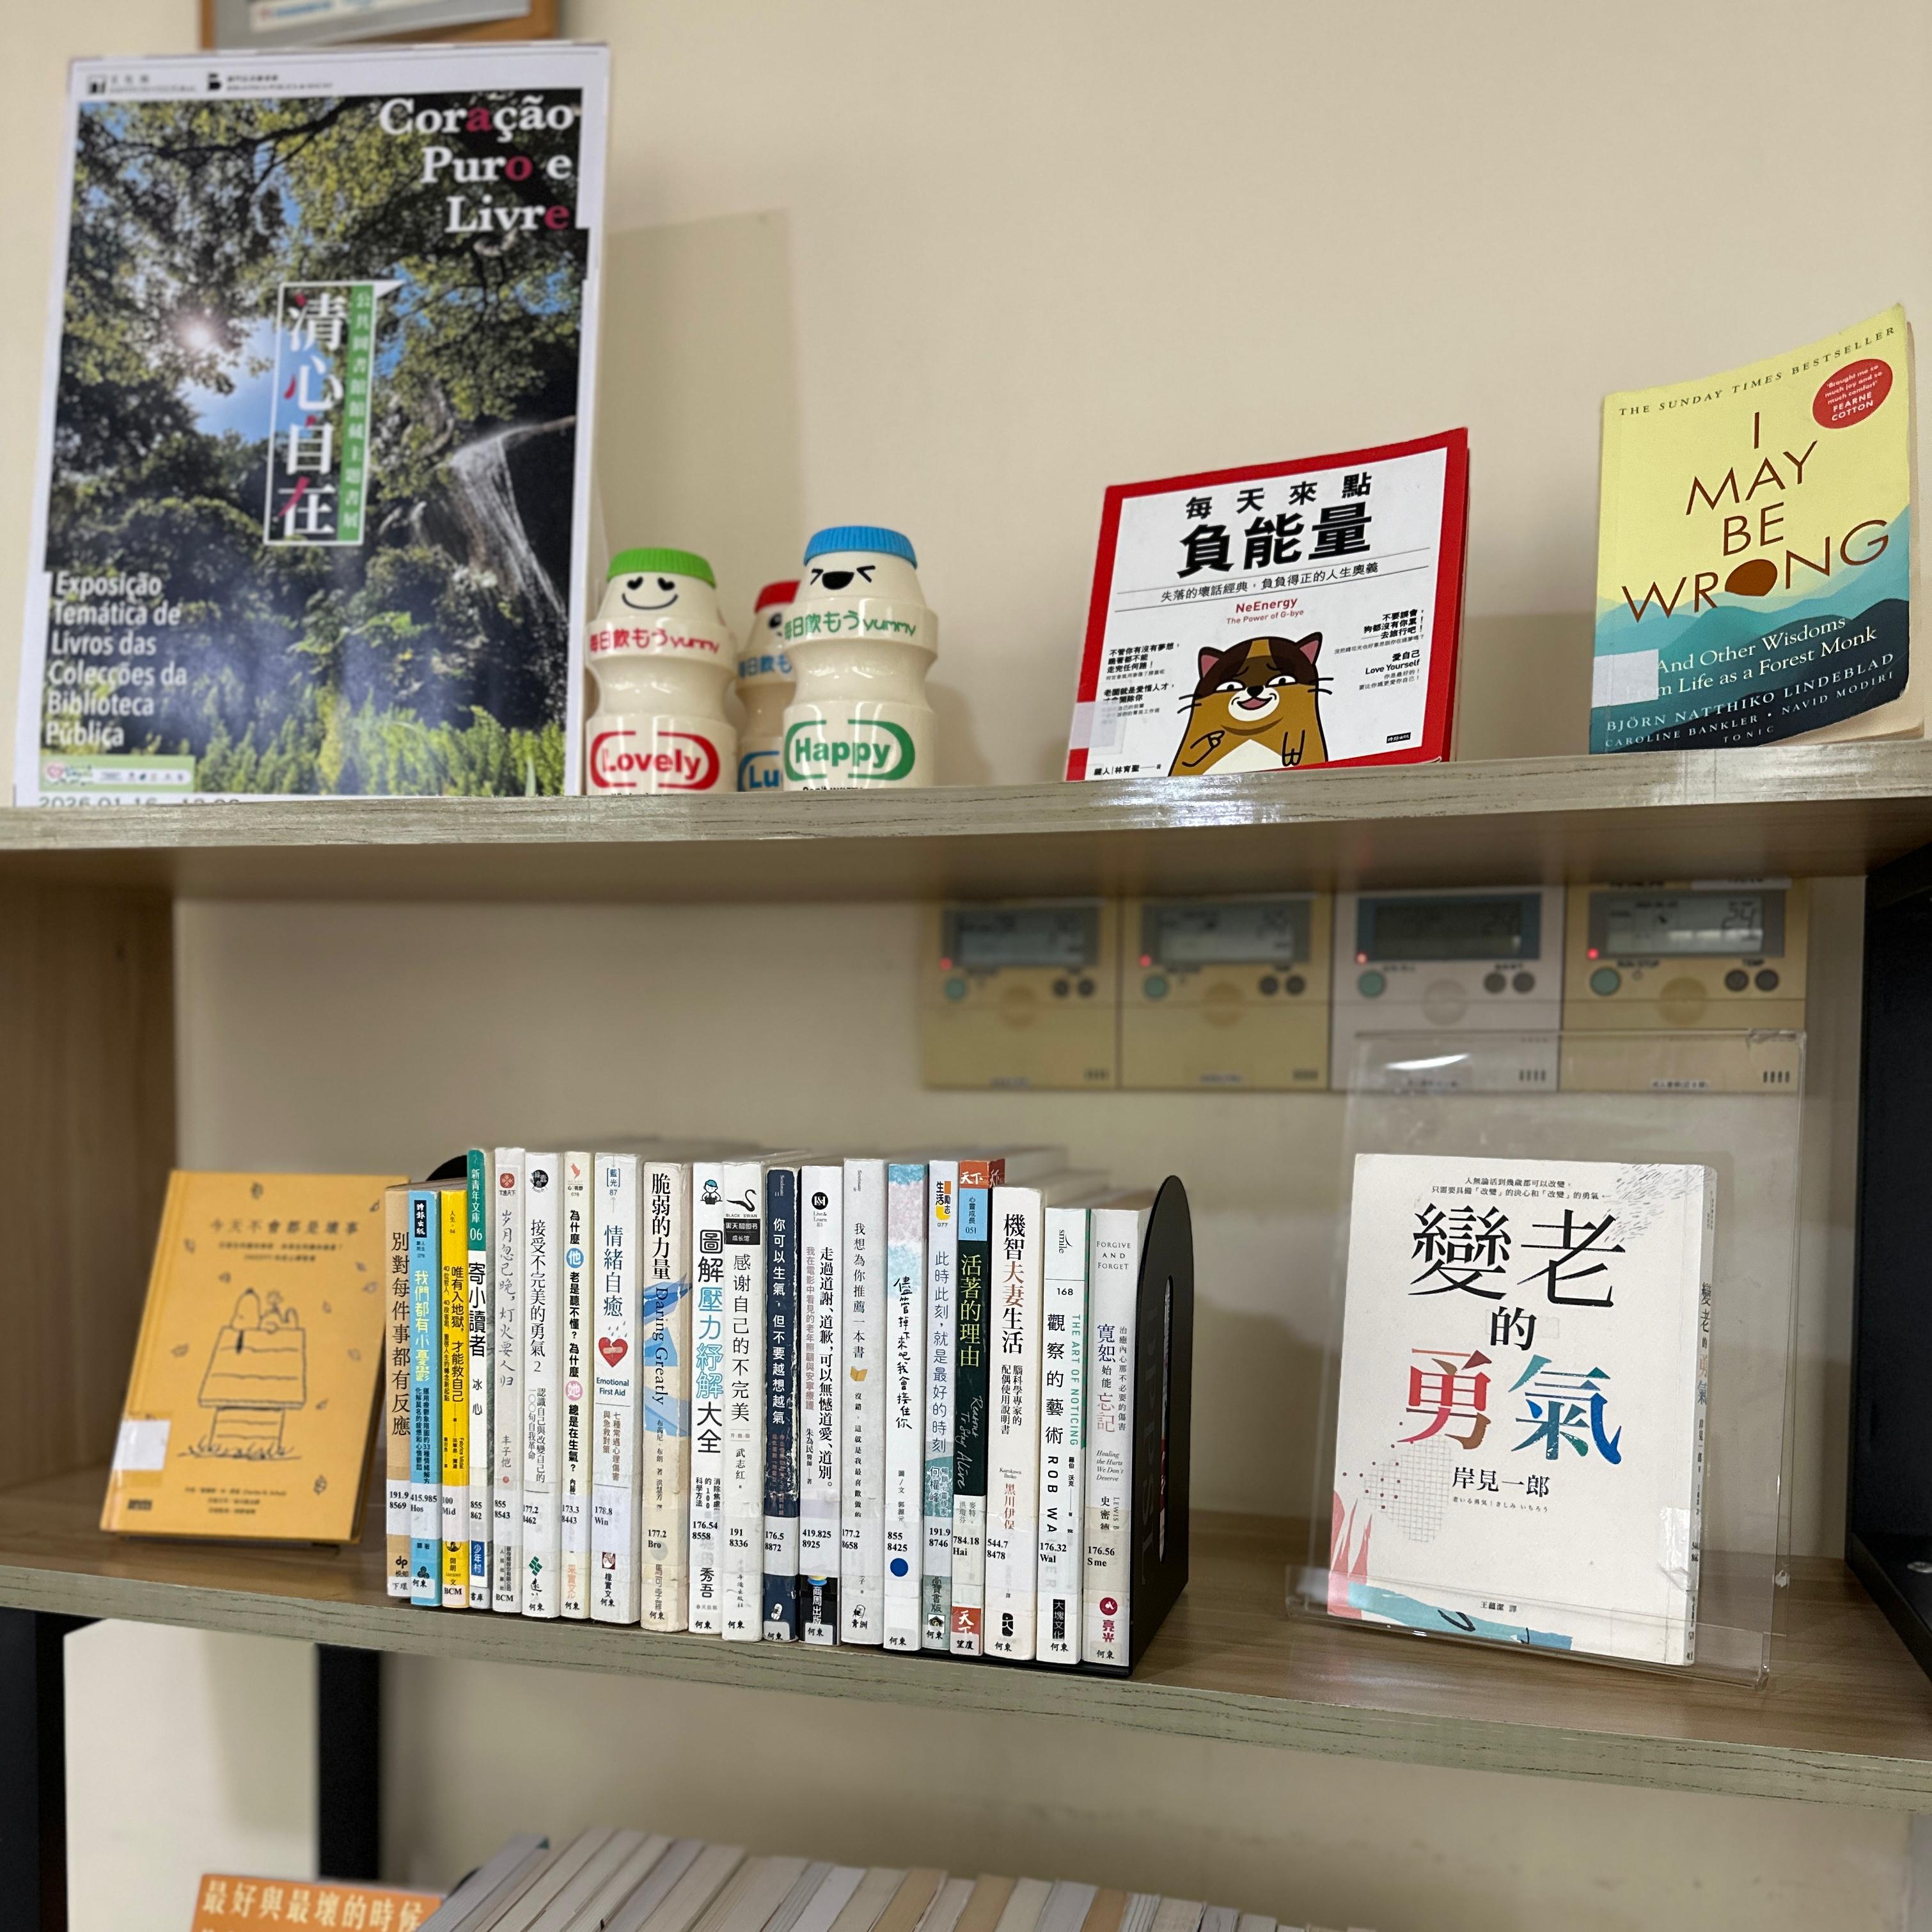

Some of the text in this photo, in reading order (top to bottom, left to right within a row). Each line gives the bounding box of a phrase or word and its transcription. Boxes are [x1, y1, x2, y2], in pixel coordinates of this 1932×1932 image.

[380, 97, 574, 143] Coração
[421, 146, 571, 183] Puro e
[444, 196, 570, 233] Livre
[1619, 326, 1896, 416] THE SUNDAY TIMES BESTSELLER
[1833, 391, 1873, 412] FEARNE
[277, 292, 349, 537] 清心自在
[1831, 400, 1874, 421] COTTON
[1753, 411, 1760, 450] I
[1685, 440, 1818, 516] MAY
[1185, 471, 1372, 520] 每天來點
[1723, 501, 1785, 556] BE
[1177, 501, 1373, 579] 負能量
[1622, 518, 1890, 624] WRONG
[56, 570, 162, 602] Exposição
[1236, 598, 1298, 613] NeEnergy
[52, 601, 182, 626] Temática de
[1227, 617, 1241, 625] The
[1243, 614, 1269, 624] Power
[51, 630, 157, 656] Livros das
[1699, 617, 1846, 667] Other Wisdoms
[1392, 649, 1420, 662] 愛自己
[1678, 673, 1714, 693] Life
[1720, 672, 1738, 685] as
[1743, 669, 1753, 679] a
[1759, 648, 1815, 677] Forest
[1820, 626, 1878, 658] Monk
[1365, 658, 1420, 675] Love Yourself
[48, 659, 188, 691] Colecções da
[1606, 713, 1667, 732] BJÖRN
[1675, 691, 1775, 723] NATTHIKO
[1784, 652, 1895, 698] LINDEBLAD
[47, 690, 155, 717] Biblioteca
[1605, 671, 1894, 748] CAROLINE BANKLER NAVID MODIRI
[45, 720, 125, 747] Pública
[1723, 725, 1775, 744] TONIC
[795, 737, 891, 770] Happy
[602, 748, 702, 781] Lovely
[651, 1172, 671, 1280] 脆弱的力量
[469, 1227, 483, 1241] 06
[1096, 1241, 1131, 1249] FORGIVE
[1408, 1202, 1626, 1308] 變老
[603, 1225, 624, 1317] 情緒自癒
[1097, 1262, 1129, 1270] FORGET
[530, 1219, 546, 1357] 接受不完美的勇氣
[1001, 1213, 1026, 1355] 機智夫妻生活
[853, 1222, 866, 1359] 我想為你推薦一本書
[1056, 1287, 1074, 1296] 168
[468, 1262, 487, 1358] 寄小讀者
[959, 1253, 982, 1368] 活著的理由
[391, 1231, 411, 1436] 別對每件事都有反應
[1489, 1305, 1537, 1351] 的
[696, 1229, 725, 1454] 圖解壓力紓解大全
[731, 1253, 751, 1422] 感谢自己的不完美
[652, 1287, 669, 1406] Daring Greatly
[931, 1251, 950, 1454] 此時此刻，就是最好的時刻
[596, 1377, 630, 1387] Emotional
[1045, 1313, 1066, 1445] 觀察的藝術
[1069, 1314, 1081, 1445] THE ART OF NOTICING
[471, 1378, 483, 1415] 冰心
[599, 1386, 626, 1397] First Aid
[1396, 1347, 1623, 1465] 勇氣
[501, 1434, 512, 1468] 丰子恺
[1096, 1450, 1120, 1459] Healing
[735, 1448, 746, 1480] 武志红
[1047, 1456, 1059, 1493] ROB
[1452, 1466, 1551, 1498] 岸見一郎
[389, 1491, 409, 1500] 191.9
[410, 1493, 437, 1502] 415.985
[389, 1501, 407, 1509] 8569
[410, 1504, 424, 1512] Hos
[470, 1501, 483, 1509] 855
[494, 1500, 507, 1508] 855
[562, 1505, 579, 1514] 173.3
[470, 1512, 483, 1520] 862
[494, 1511, 511, 1520] 8543
[594, 1505, 613, 1516] 178.8
[594, 1516, 609, 1527] Win
[692, 1520, 718, 1530] 176.54
[647, 1529, 667, 1539] 177.2
[692, 1531, 711, 1541] 8558
[730, 1528, 744, 1537] 191
[765, 1530, 785, 1541] 176.5
[802, 1528, 832, 1539] 419.825
[842, 1528, 861, 1539] 177.2
[887, 1531, 904, 1541] 855
[929, 1527, 951, 1537] 191.9
[647, 1539, 662, 1550] Bro
[729, 1538, 749, 1548] 8336
[802, 1539, 821, 1549] 8925
[842, 1540, 859, 1550] 8658
[929, 1538, 949, 1548] 8746
[953, 1535, 980, 1546] 784.18
[987, 1538, 1009, 1548] 544.7
[764, 1543, 782, 1553] 8872
[887, 1543, 908, 1553] 8425
[953, 1547, 968, 1557] Hai
[1039, 1542, 1067, 1553] 176.32
[1087, 1546, 1115, 1557] 176.56
[987, 1550, 1007, 1560] 8478
[1039, 1553, 1056, 1564] Wal
[412, 1579, 428, 1588] 何東
[700, 1567, 715, 1598] 秀吾
[444, 1587, 462, 1596] BCM
[495, 1593, 514, 1603] BCM
[600, 1598, 615, 1608] 何東
[529, 1602, 544, 1612] 何東
[565, 1601, 580, 1611] 何東
[649, 1610, 666, 1621] 何東
[695, 1620, 712, 1630] 何東
[728, 1619, 745, 1630] 何東
[851, 1619, 868, 1630] 青洲
[767, 1631, 784, 1641] 何東
[807, 1627, 824, 1637] 何東
[925, 1630, 943, 1640] 何東
[889, 1637, 907, 1647] 何東
[995, 1642, 1012, 1652] 何東
[1050, 1642, 1069, 1653] 何東
[1096, 1649, 1115, 1660] 何東
